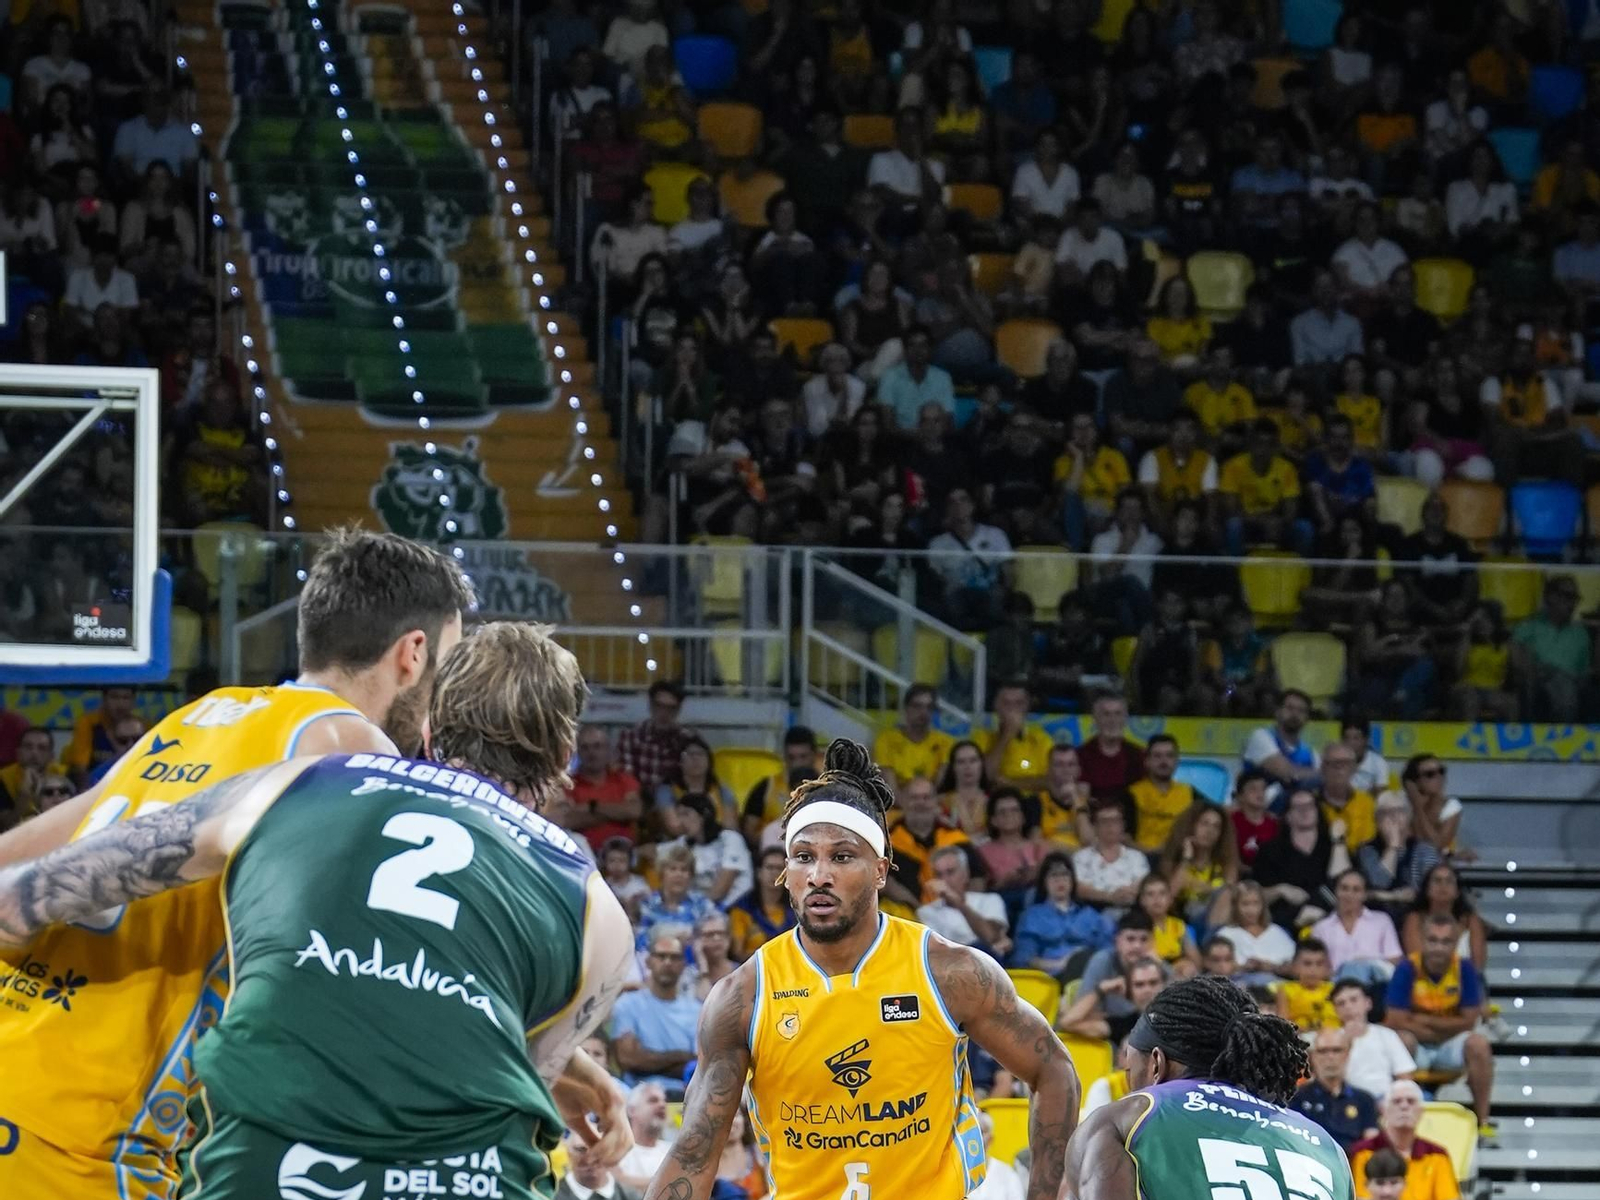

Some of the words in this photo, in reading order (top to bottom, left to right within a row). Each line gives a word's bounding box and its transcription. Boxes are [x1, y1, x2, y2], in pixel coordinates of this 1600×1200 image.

[74, 612, 99, 627] liga
[74, 625, 127, 639] endesa
[366, 811, 476, 931] 2
[772, 988, 810, 1000] SPALDING
[883, 1004, 900, 1013] liga
[884, 1010, 918, 1020] endesa
[384, 1168, 447, 1194] DEL
[452, 1171, 504, 1199] SOL
